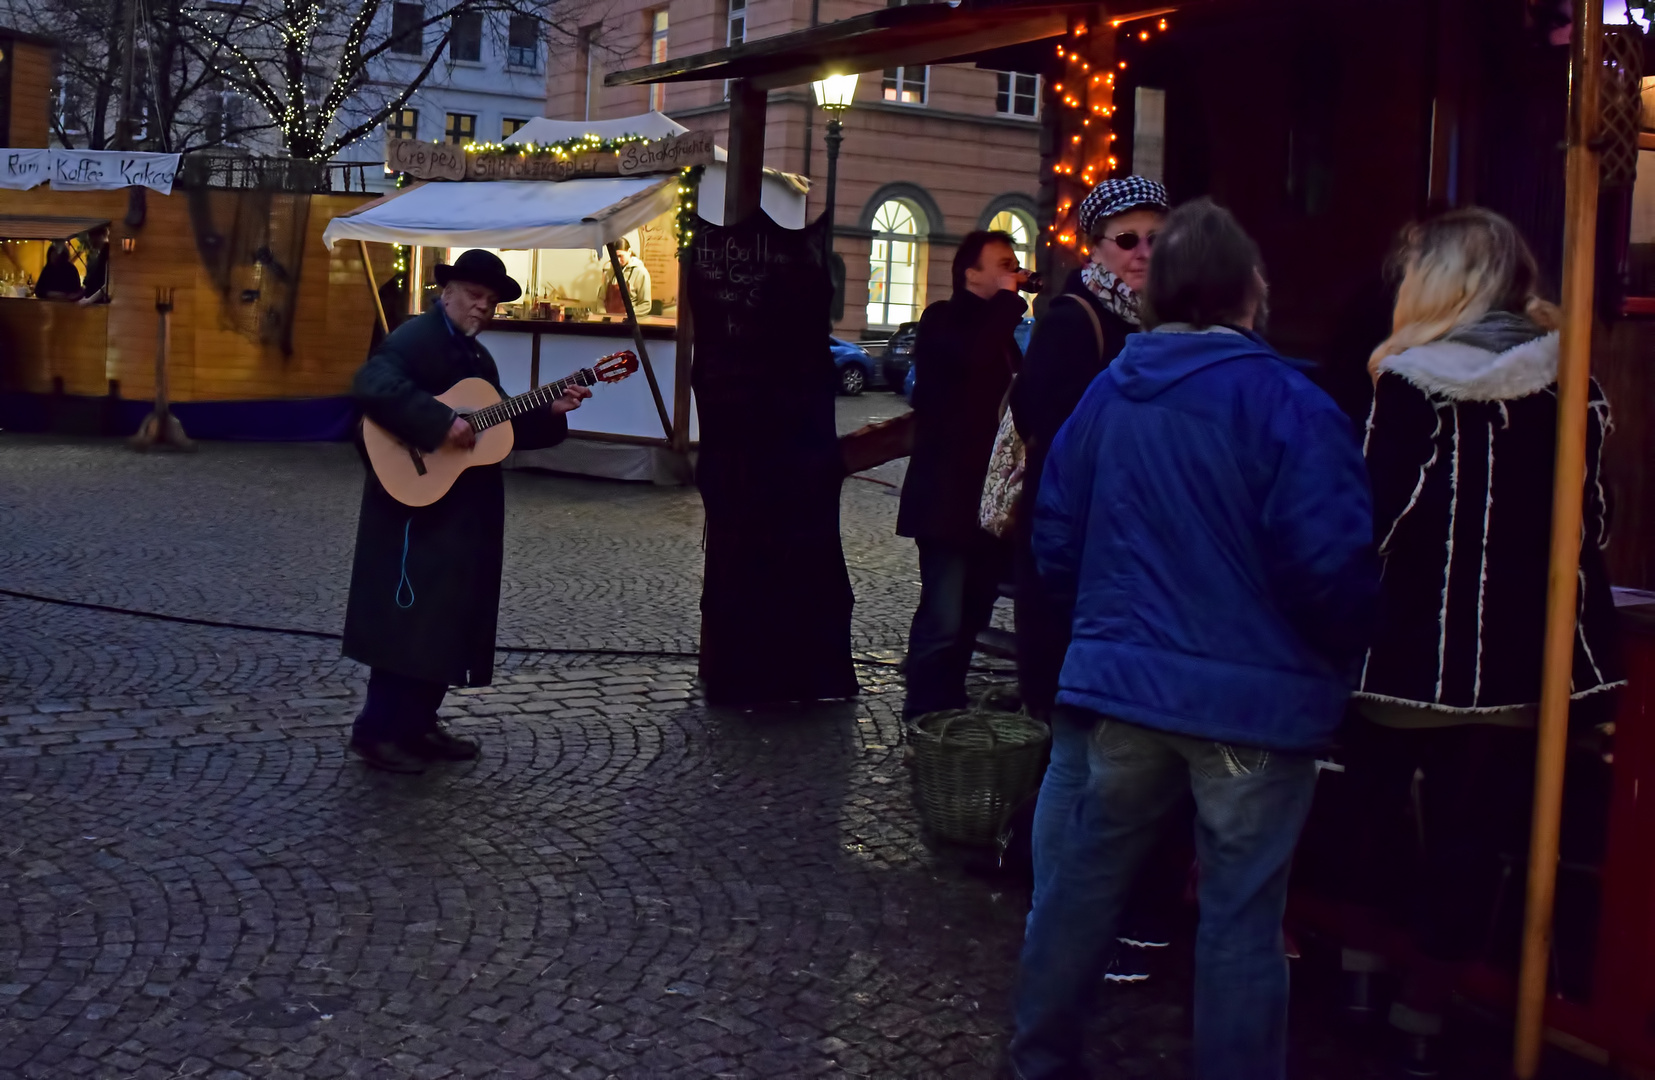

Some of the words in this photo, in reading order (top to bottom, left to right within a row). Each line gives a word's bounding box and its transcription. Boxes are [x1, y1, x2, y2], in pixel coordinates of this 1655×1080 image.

[8, 153, 39, 176] Rum
[57, 157, 104, 183] Kaffee
[120, 158, 175, 185] Kakao
